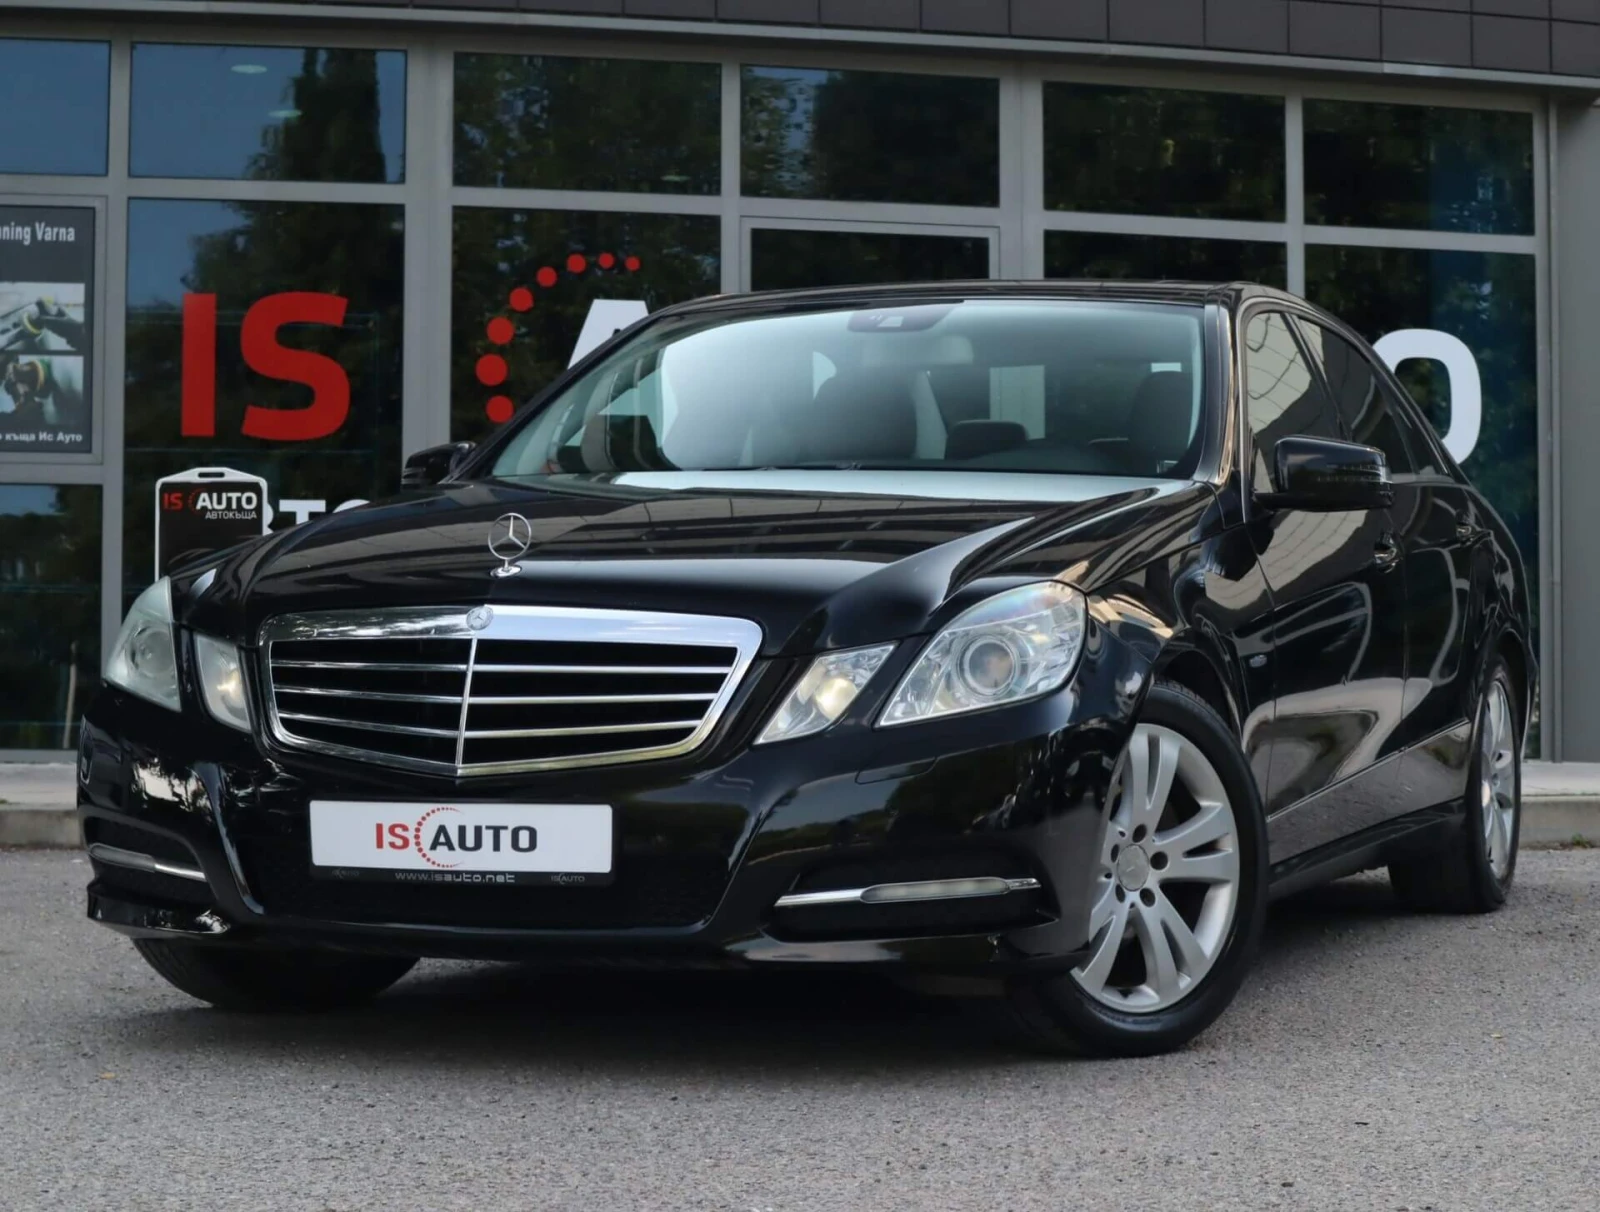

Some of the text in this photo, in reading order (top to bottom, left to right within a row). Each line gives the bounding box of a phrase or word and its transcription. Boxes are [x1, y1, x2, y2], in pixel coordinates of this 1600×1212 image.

[0, 222, 75, 246] ning Varna
[181, 291, 351, 440] IS
[39, 431, 54, 441] Ис
[57, 431, 83, 444] Ауто
[164, 492, 258, 510] IS AUTO
[205, 511, 258, 520] АВТОКЪЩА
[375, 823, 538, 852] IS AUTO
[394, 871, 516, 883] www.isauto.net
